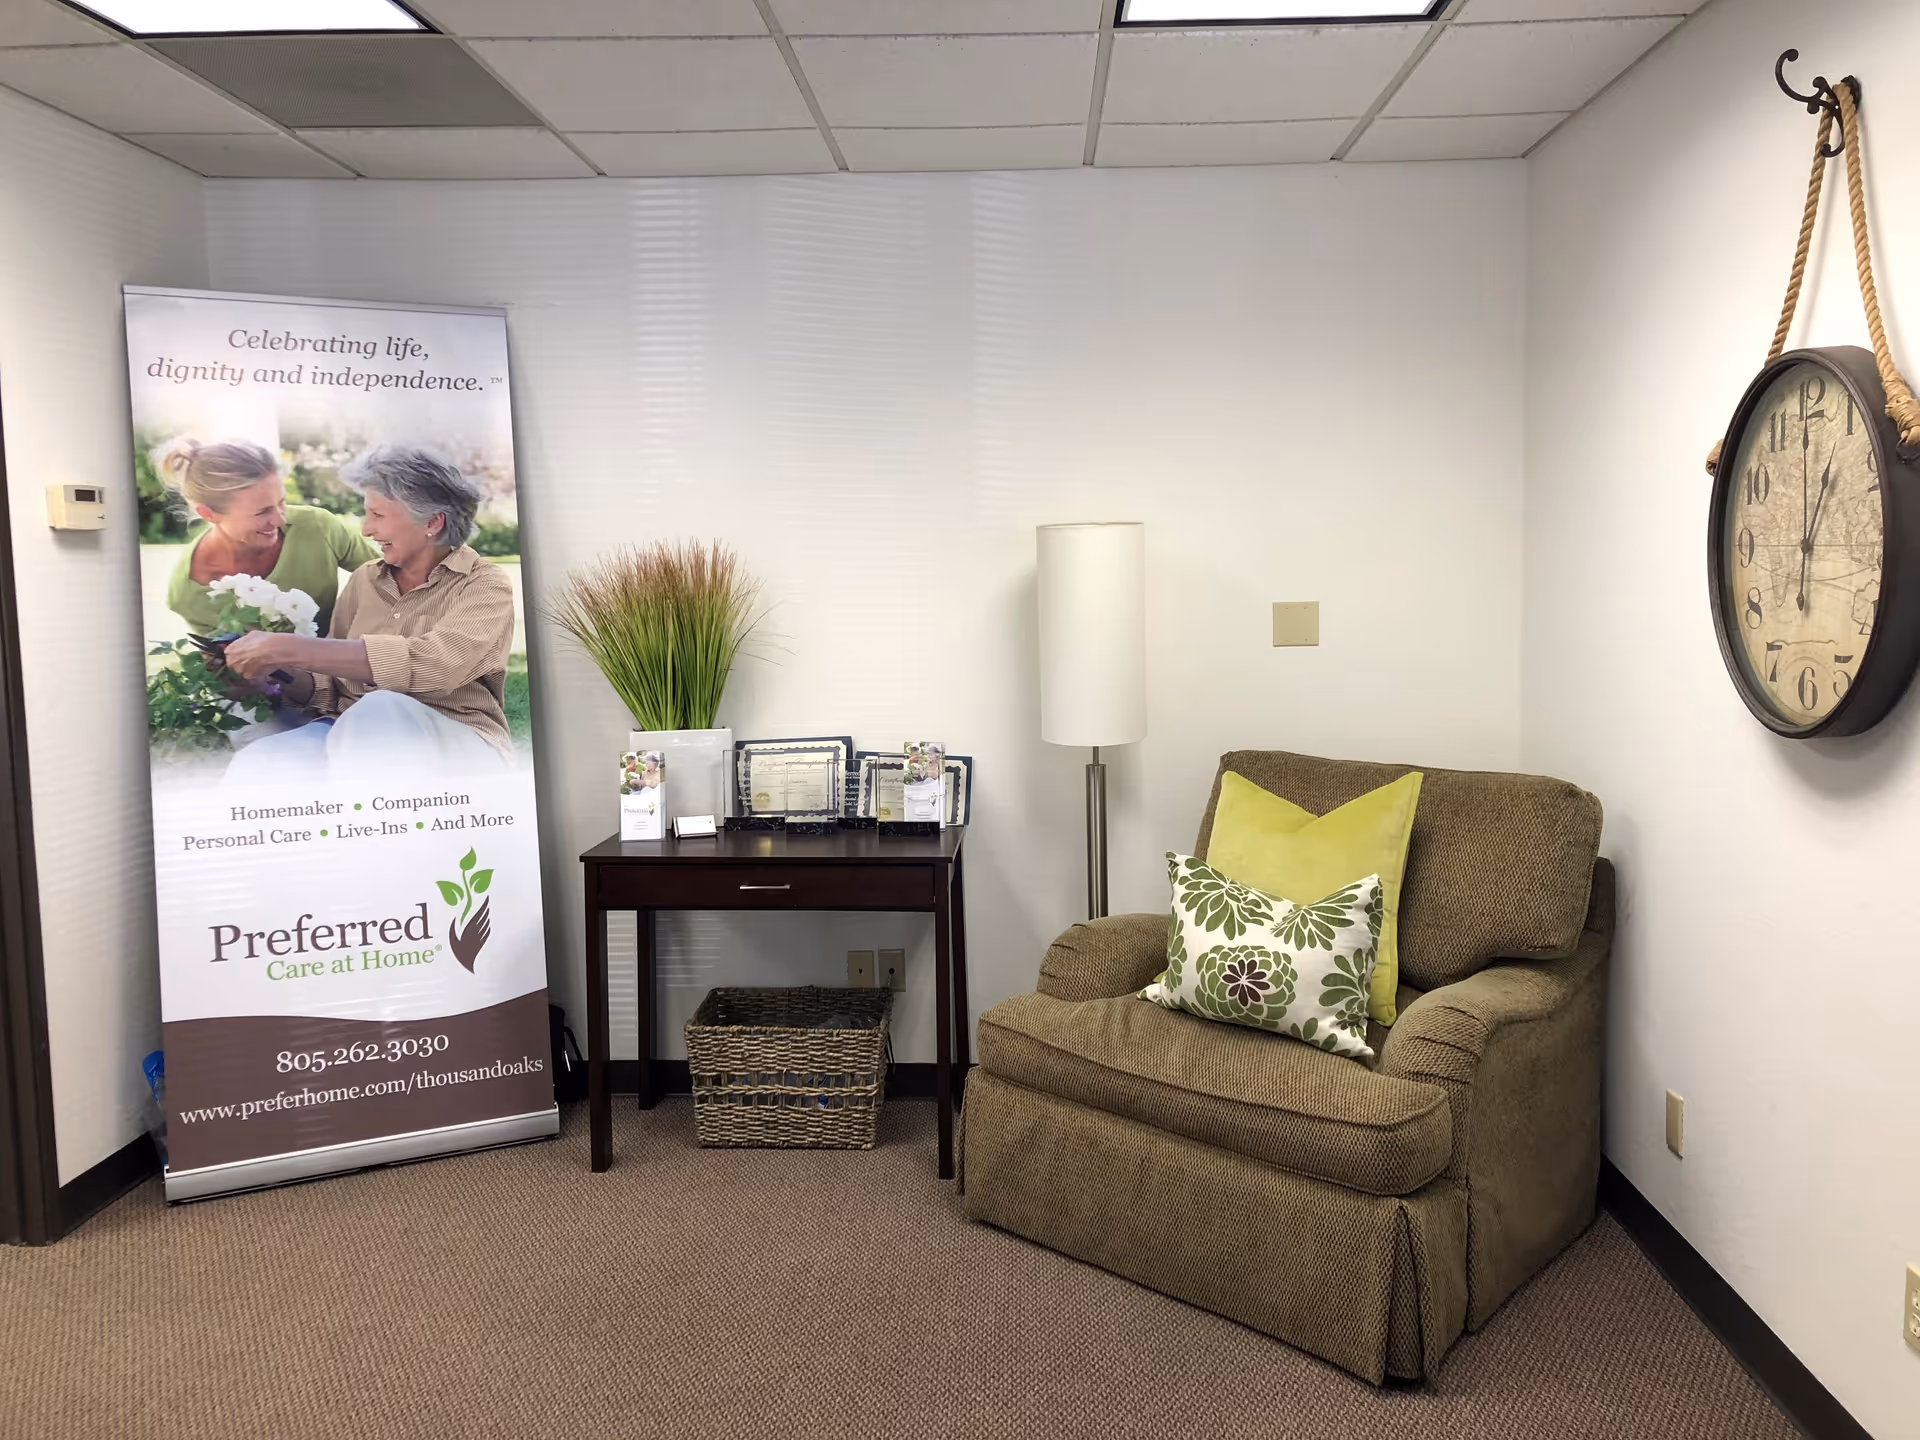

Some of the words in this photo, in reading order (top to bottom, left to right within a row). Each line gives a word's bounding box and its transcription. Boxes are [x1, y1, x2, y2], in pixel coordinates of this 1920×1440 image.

[228, 329, 378, 360] Celebrating
[385, 335, 429, 361] life,
[147, 357, 244, 386] dignity
[253, 365, 302, 384] and
[1798, 376, 1826, 422] 12
[1844, 392, 1856, 436] 1
[1769, 409, 1786, 453] 11
[1746, 463, 1770, 505] 10
[1738, 528, 1754, 568] 9
[1746, 587, 1762, 629] 8
[1766, 641, 1783, 682] 7
[1833, 655, 1853, 698] 5
[1798, 667, 1818, 710] 6
[230, 801, 343, 821] Homemaker
[372, 792, 470, 812] Companion
[183, 830, 264, 851] Personal
[270, 828, 312, 844] Care
[336, 822, 408, 839] Live-Ins
[431, 815, 465, 832] And
[470, 813, 514, 828] More
[208, 902, 433, 962] Preferred
[266, 960, 325, 981] Care
[331, 955, 355, 973] at
[276, 1034, 449, 1073] 805.262.3030
[180, 1056, 543, 1125] www.preferhome.com/thousandoaks
